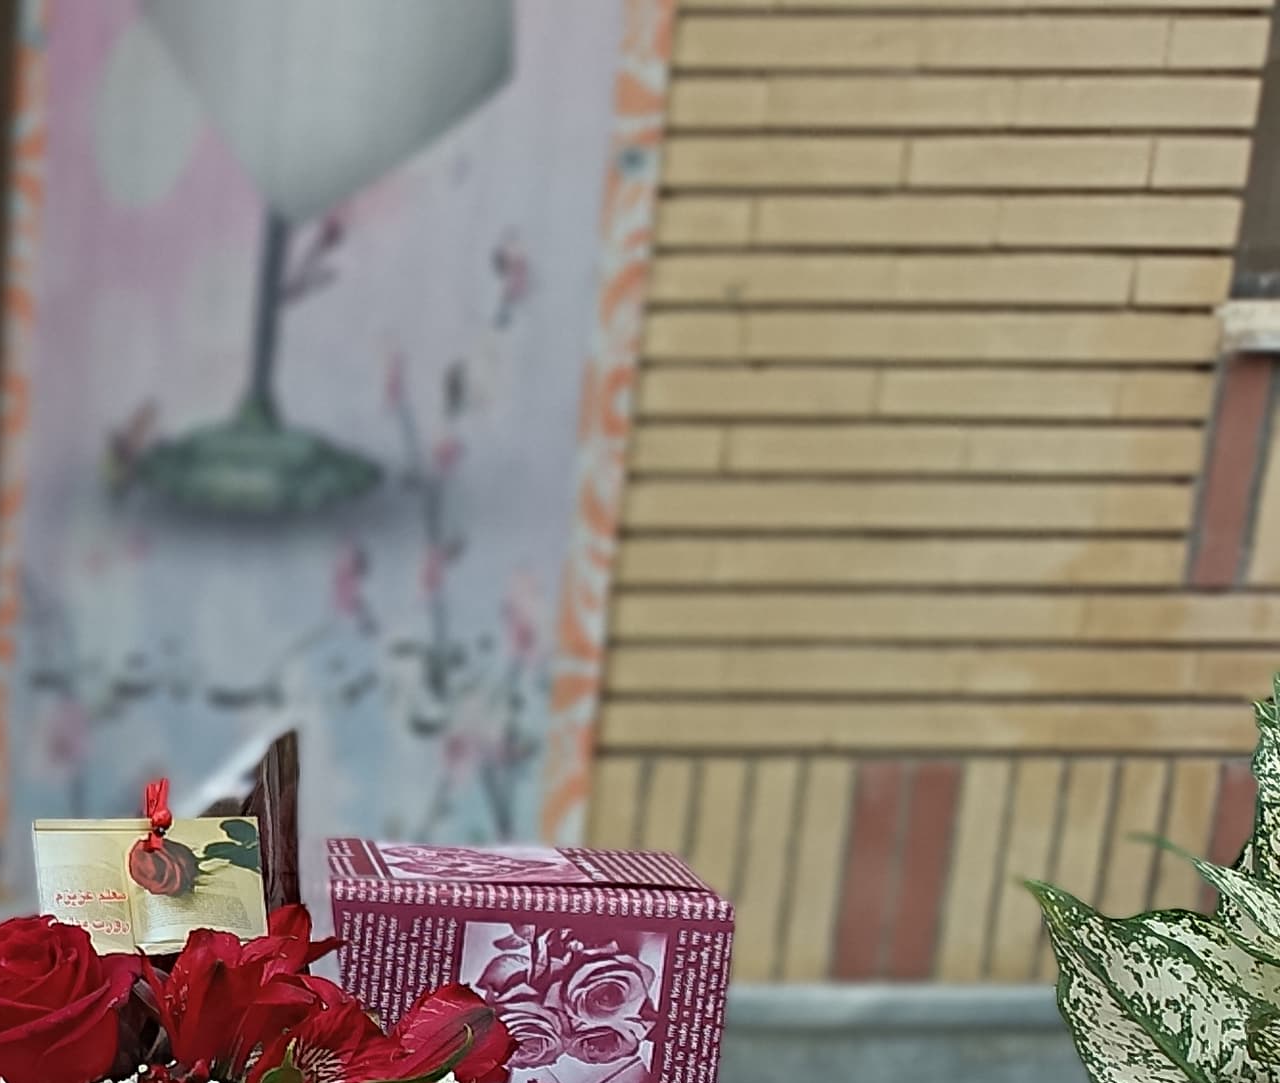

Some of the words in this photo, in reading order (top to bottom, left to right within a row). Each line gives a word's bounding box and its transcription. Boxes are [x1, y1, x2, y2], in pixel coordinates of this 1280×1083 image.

[55, 889, 93, 906] عزیزم
[99, 890, 127, 902] معلم
[92, 919, 130, 934] روزت
